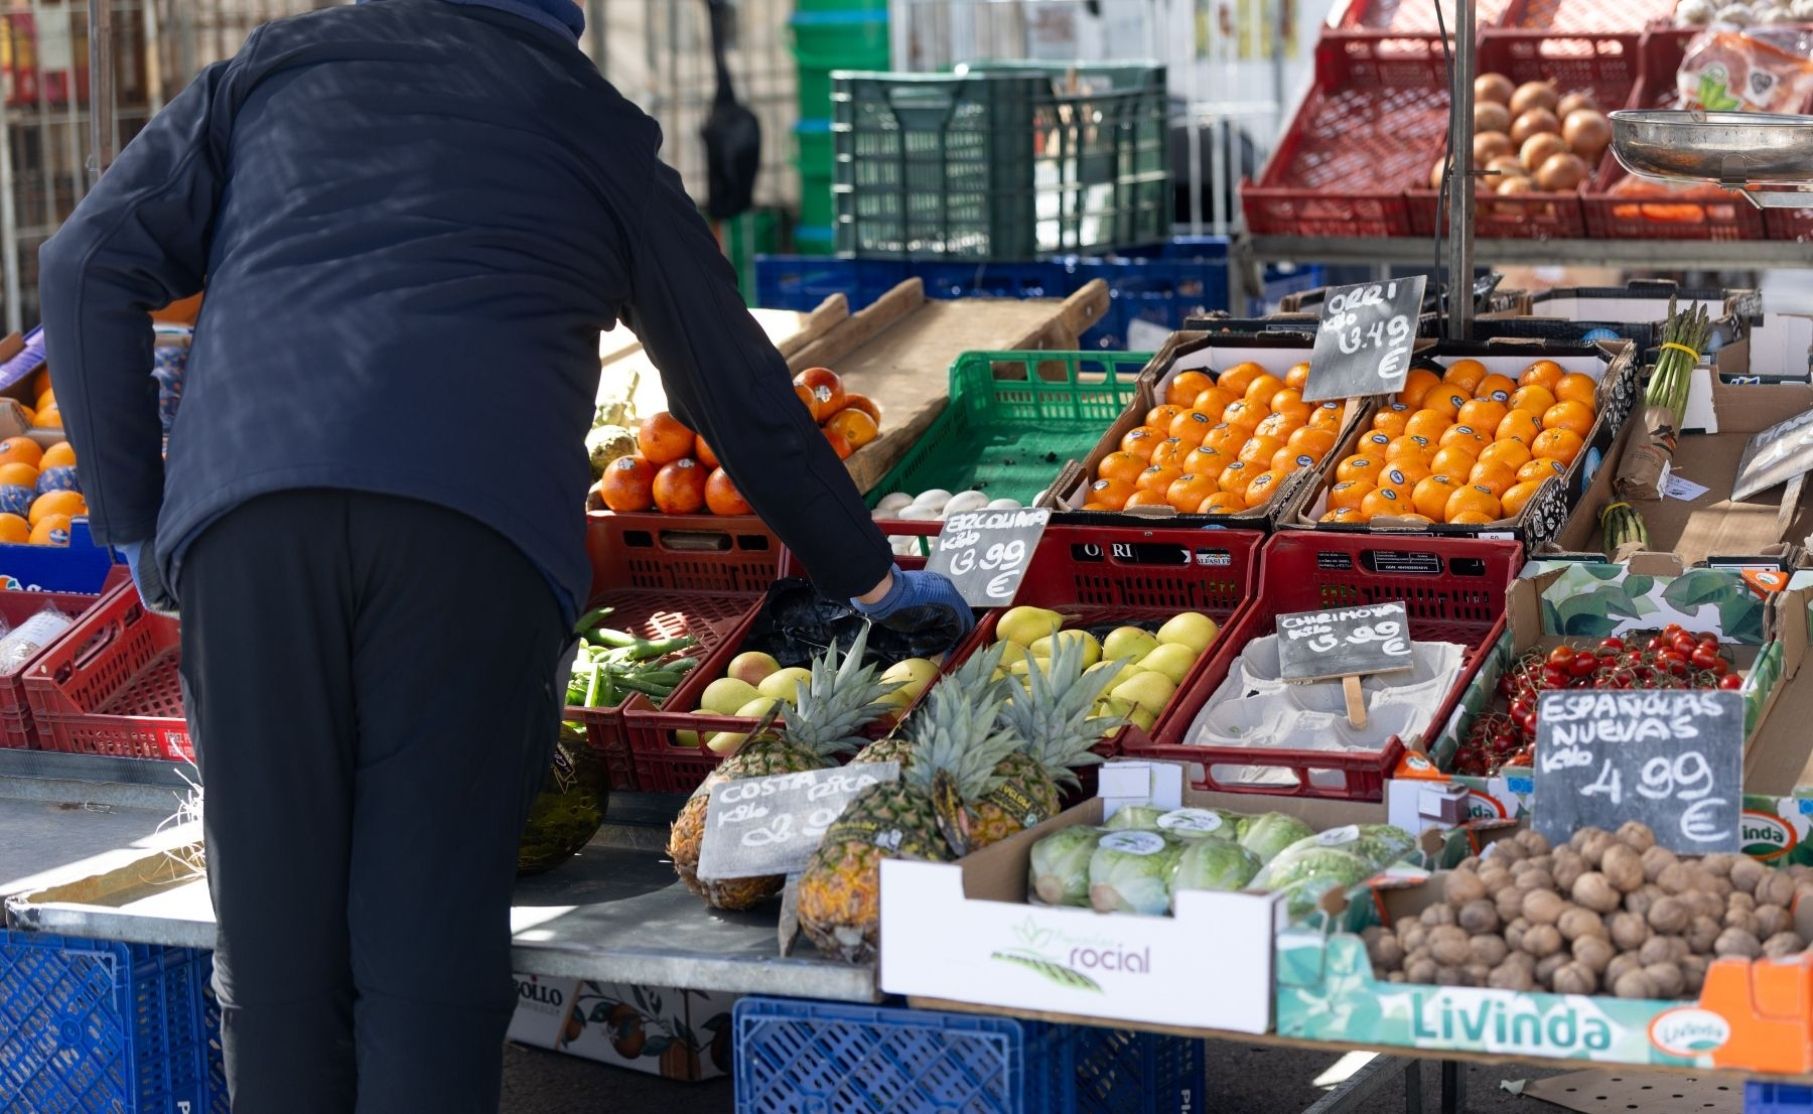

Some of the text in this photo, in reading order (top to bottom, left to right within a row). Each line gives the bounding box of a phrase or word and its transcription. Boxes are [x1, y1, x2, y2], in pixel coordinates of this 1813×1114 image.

[1328, 282, 1397, 315] ORRI
[1378, 346, 1408, 378] €
[986, 569, 1020, 598] €
[1281, 603, 1404, 629] CHIRIMOYA
[1382, 637, 1412, 656] €
[1541, 691, 1724, 721] ESPAÑOLAS
[1552, 714, 1699, 746] NUEVAS
[719, 771, 879, 804] COSTA RICA
[1680, 798, 1731, 842] €
[1742, 825, 1784, 844] inda
[1070, 944, 1151, 974] rocial
